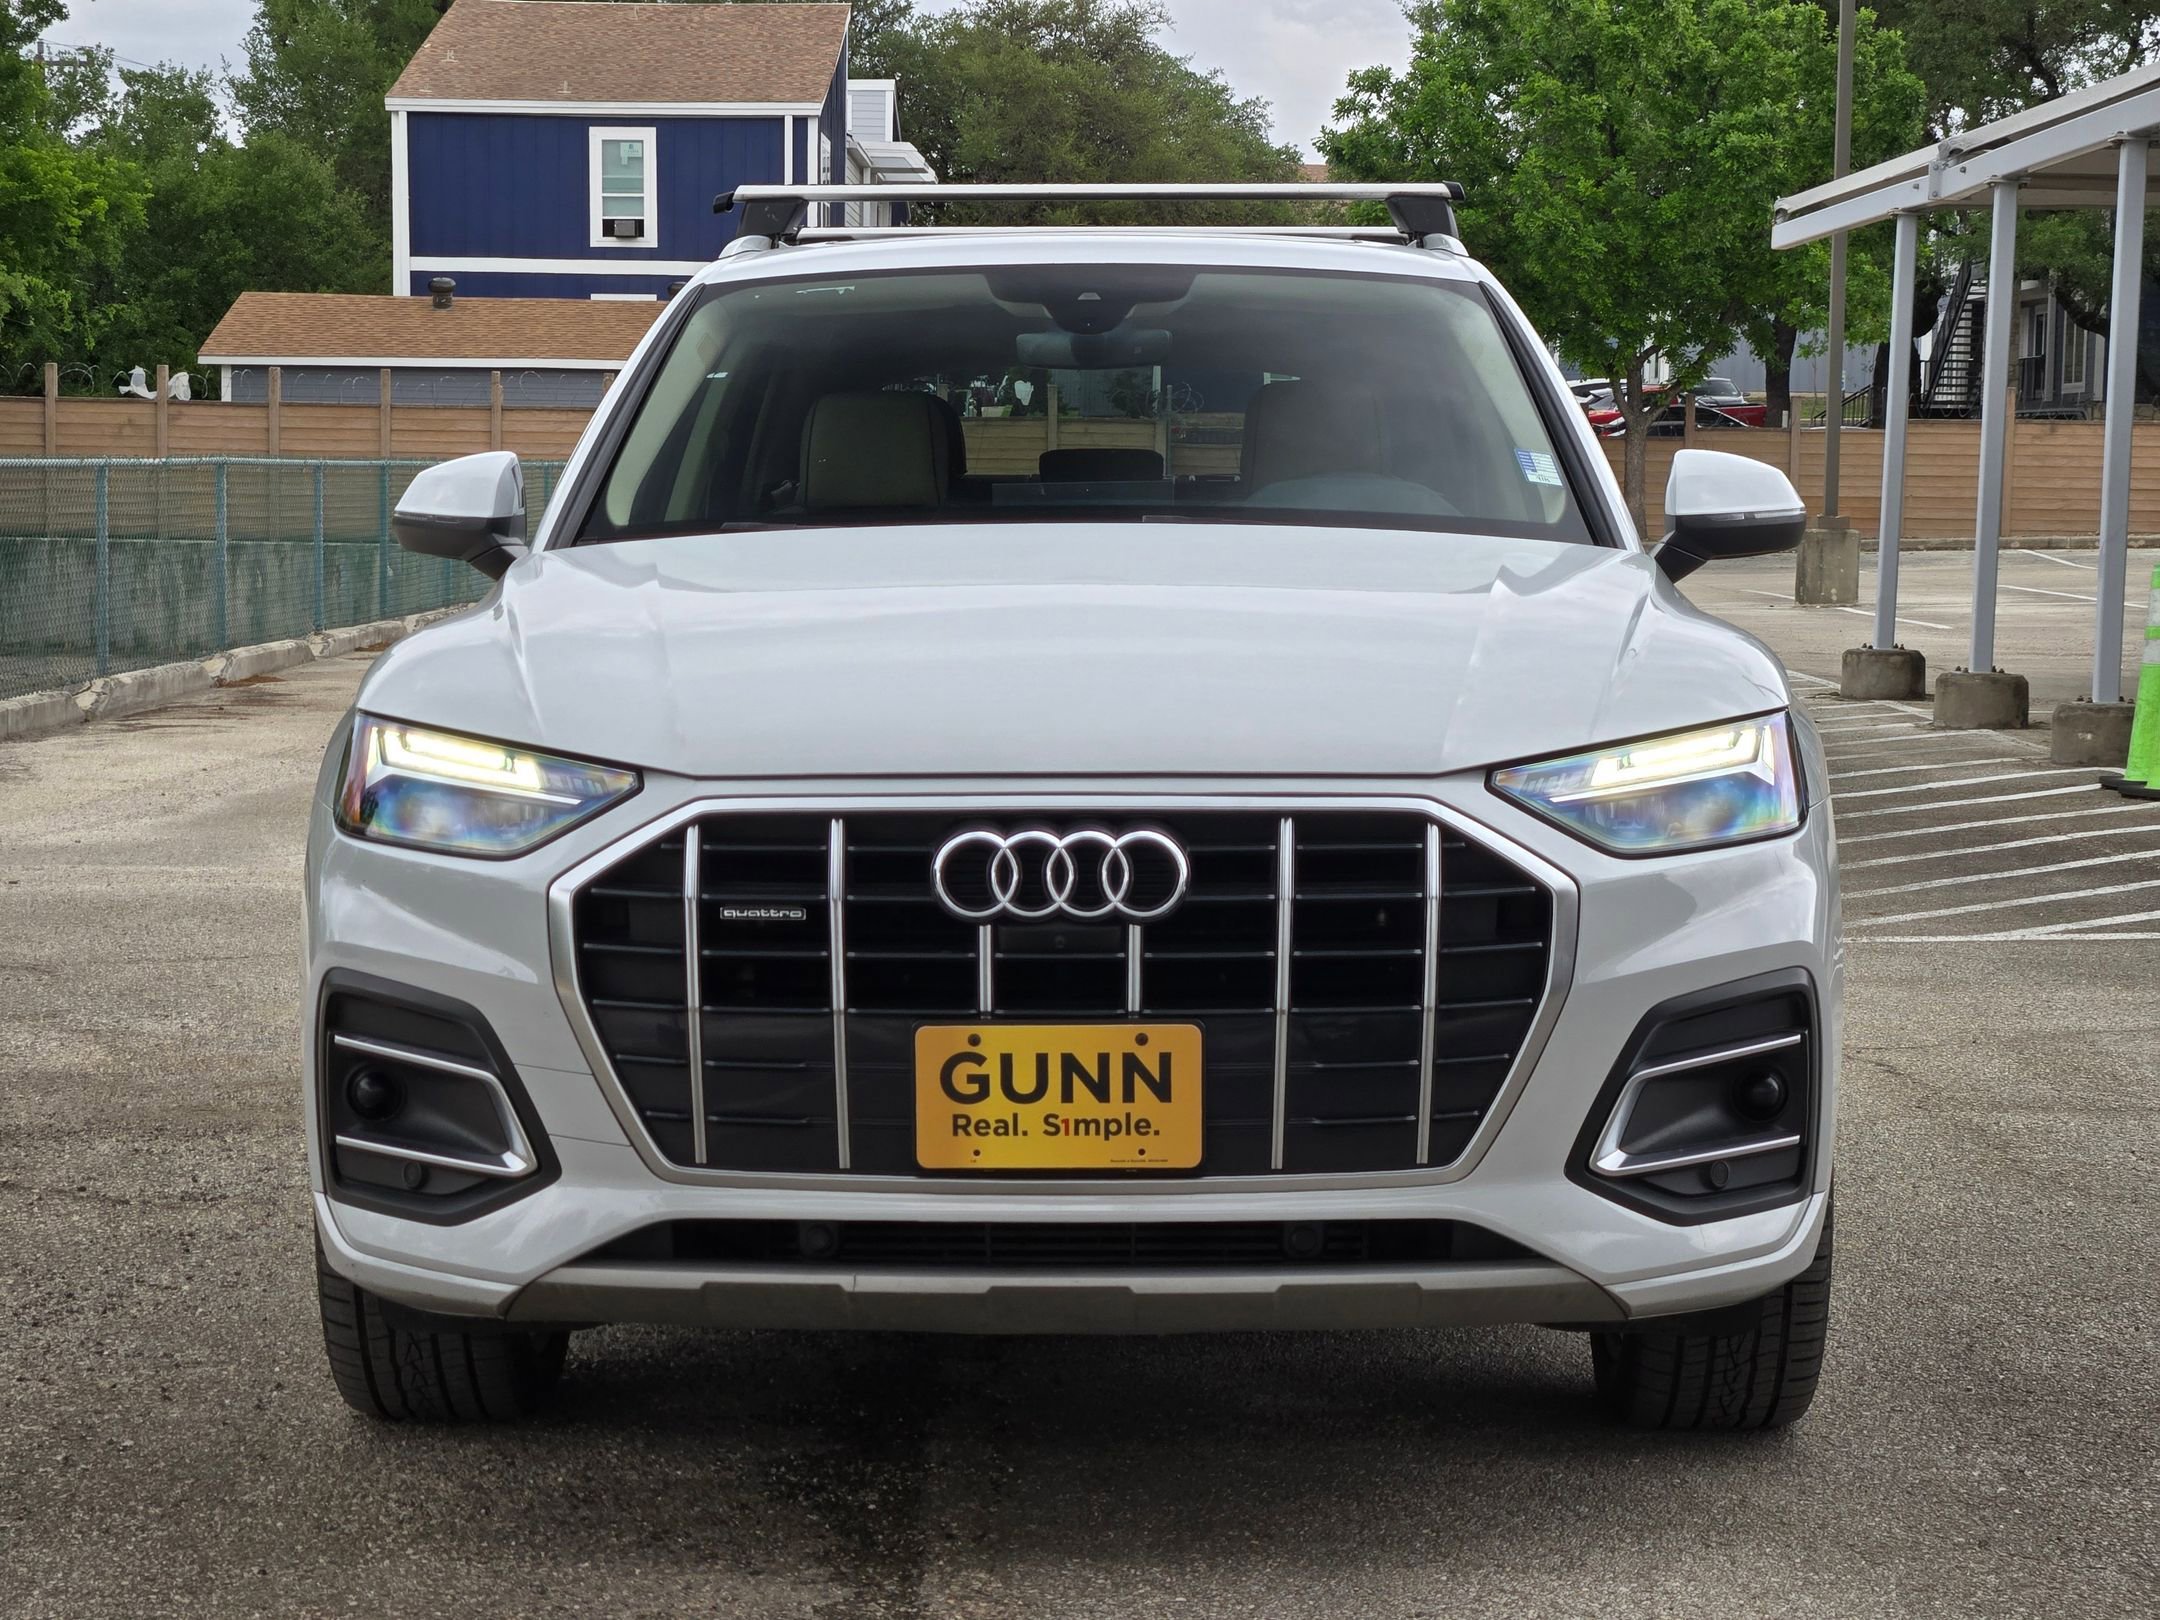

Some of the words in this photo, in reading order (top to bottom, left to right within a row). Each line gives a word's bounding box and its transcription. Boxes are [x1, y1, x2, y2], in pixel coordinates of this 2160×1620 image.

[723, 908, 803, 918] quattro
[940, 1051, 1172, 1105] GUNN
[952, 1112, 1029, 1137] Real.
[1043, 1112, 1160, 1141] S1mple.
